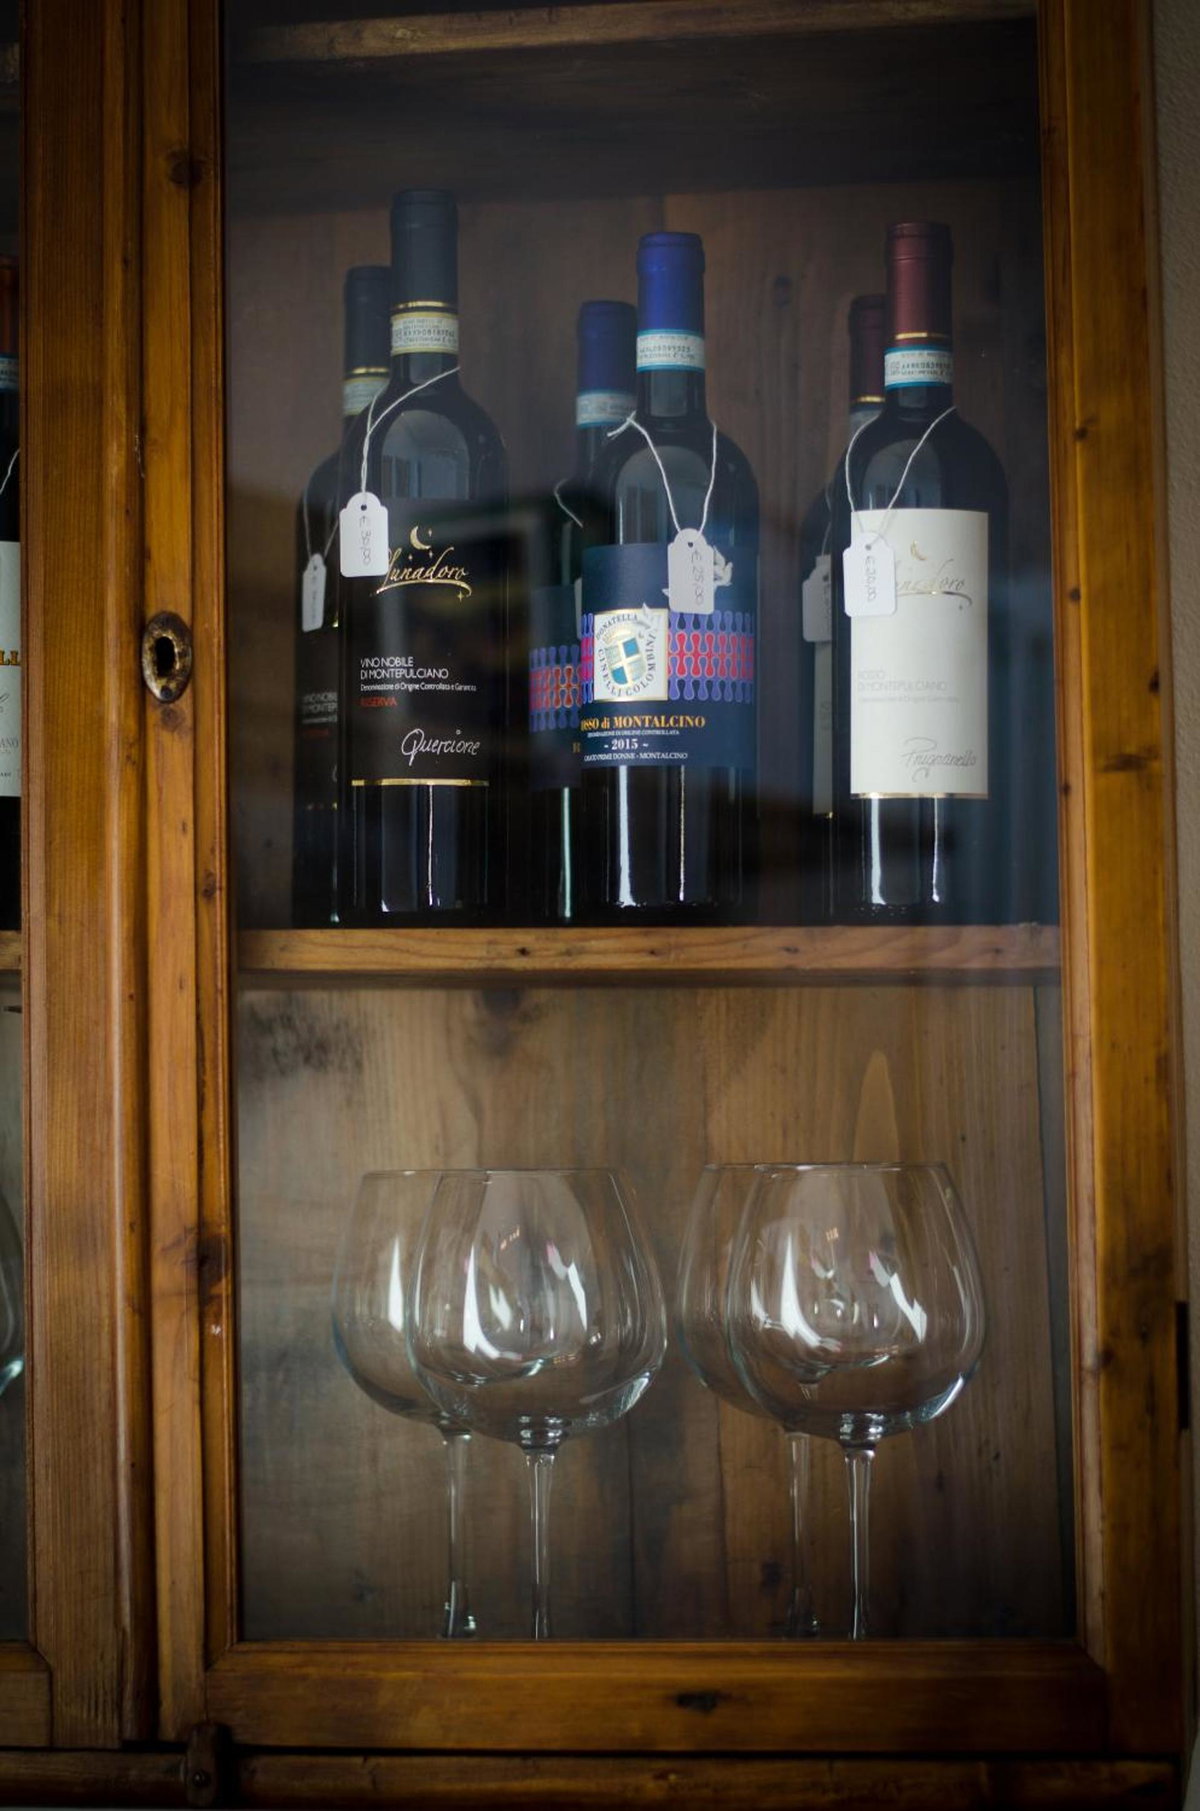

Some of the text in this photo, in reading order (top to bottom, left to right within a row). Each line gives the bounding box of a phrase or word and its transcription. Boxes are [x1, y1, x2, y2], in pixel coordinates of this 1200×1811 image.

[360, 656, 414, 668] VINO NOBILE
[360, 667, 449, 680] DI MONTEPULCIANO
[601, 716, 610, 729] di
[613, 715, 706, 729] MONTALCINO
[401, 728, 480, 767] Quercione
[611, 738, 639, 750] 2015
[638, 751, 688, 761] MONTALCINO
